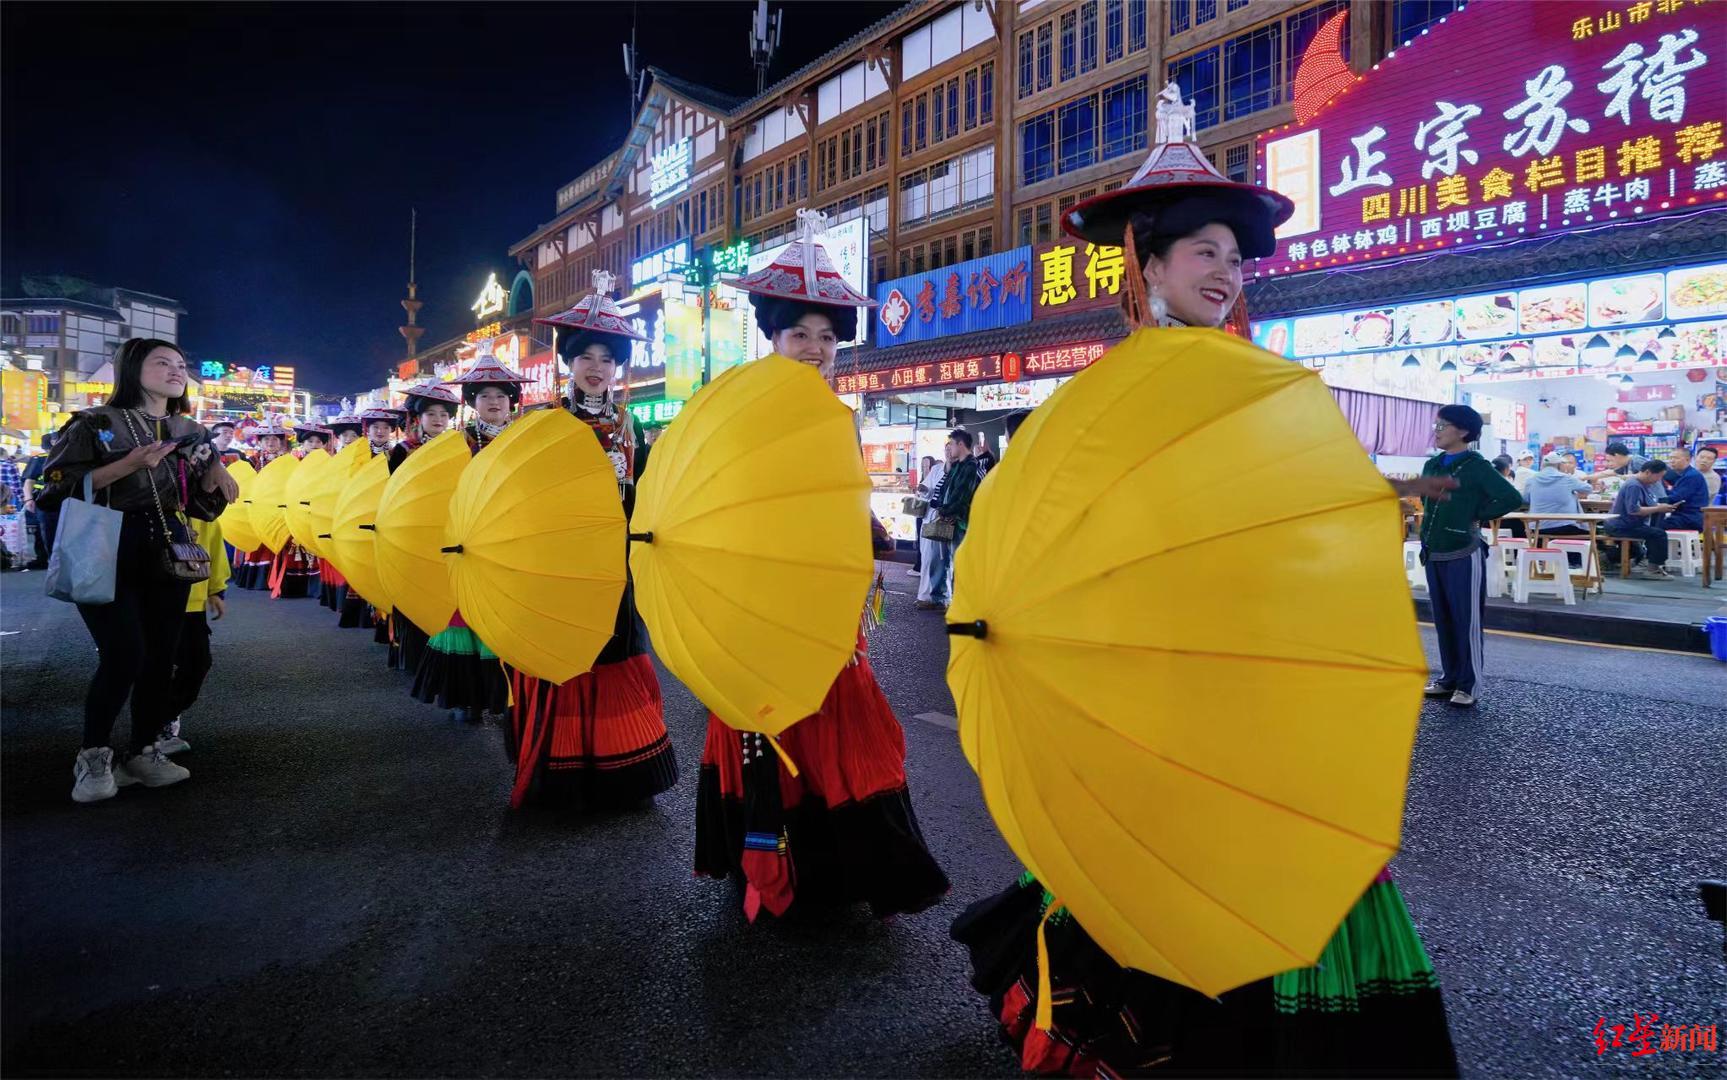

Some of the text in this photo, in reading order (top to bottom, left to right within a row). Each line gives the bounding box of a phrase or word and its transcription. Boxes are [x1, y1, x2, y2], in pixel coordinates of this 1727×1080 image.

[1572, 0, 1708, 39] 乐山市非
[1329, 29, 1708, 197] 正宗苏稽
[1361, 121, 1725, 223] 四川美食栏目推荐
[1288, 224, 1398, 262] 特色钵钵鸡
[1421, 201, 1527, 239] 西坝豆腐
[1563, 177, 1650, 215] 蒸牛肉
[1040, 242, 1125, 306] 惠得
